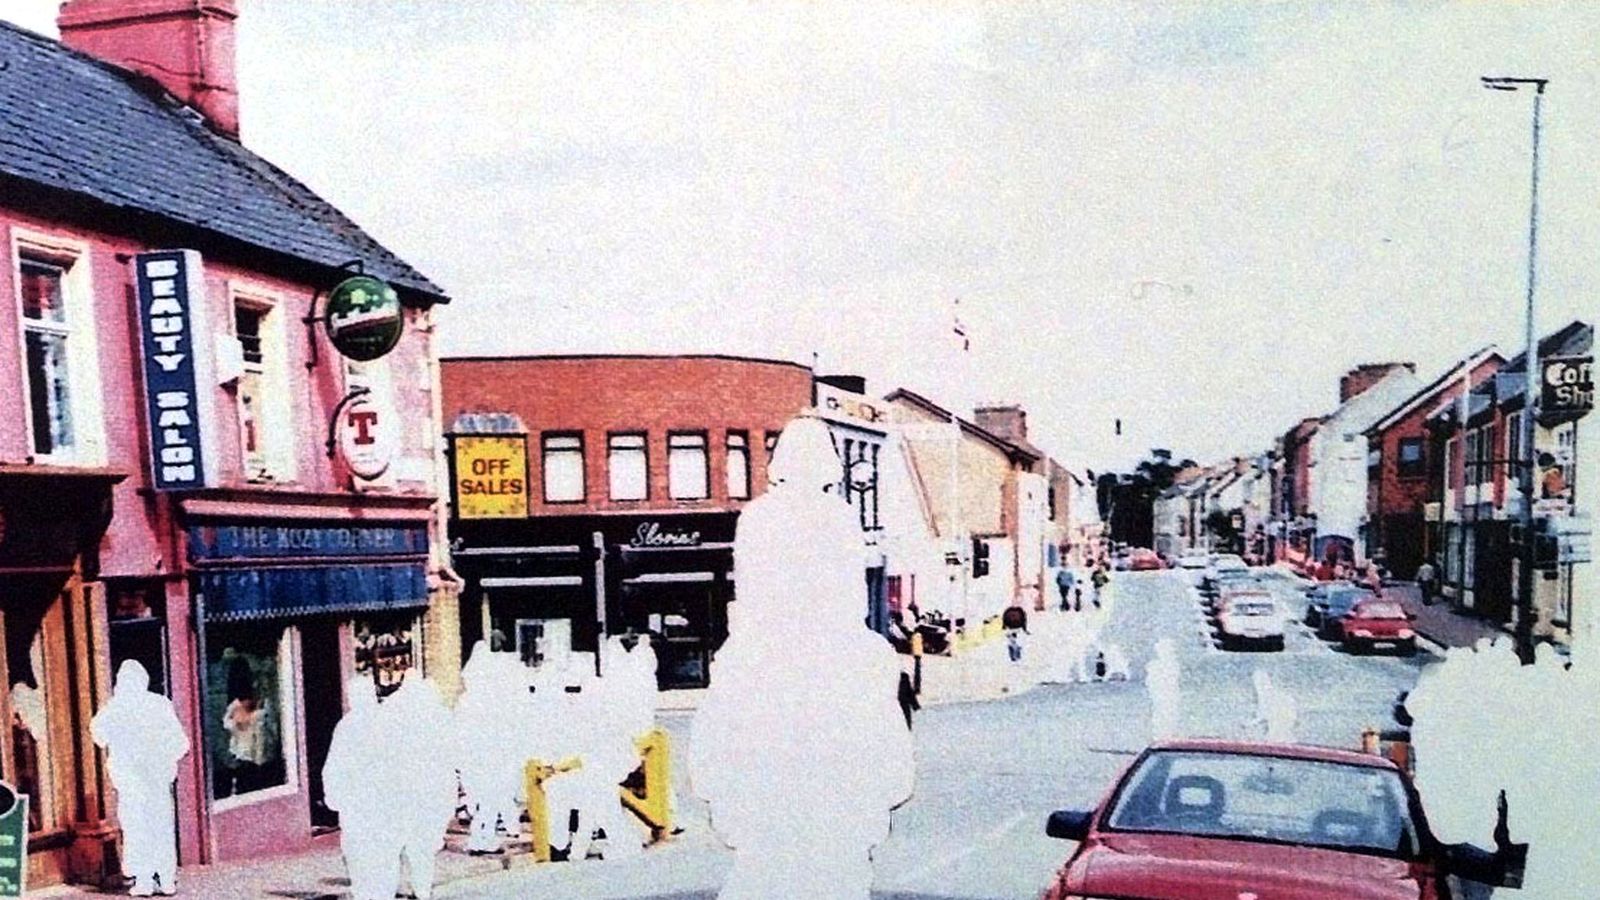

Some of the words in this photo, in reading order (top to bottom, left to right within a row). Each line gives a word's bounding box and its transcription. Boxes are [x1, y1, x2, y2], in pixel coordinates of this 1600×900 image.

[145, 260, 186, 372] BEAUTY
[156, 391, 196, 482] SALON
[348, 411, 378, 445] T
[471, 458, 510, 476] OFF
[460, 479, 523, 495] SALES
[229, 526, 271, 548] THE
